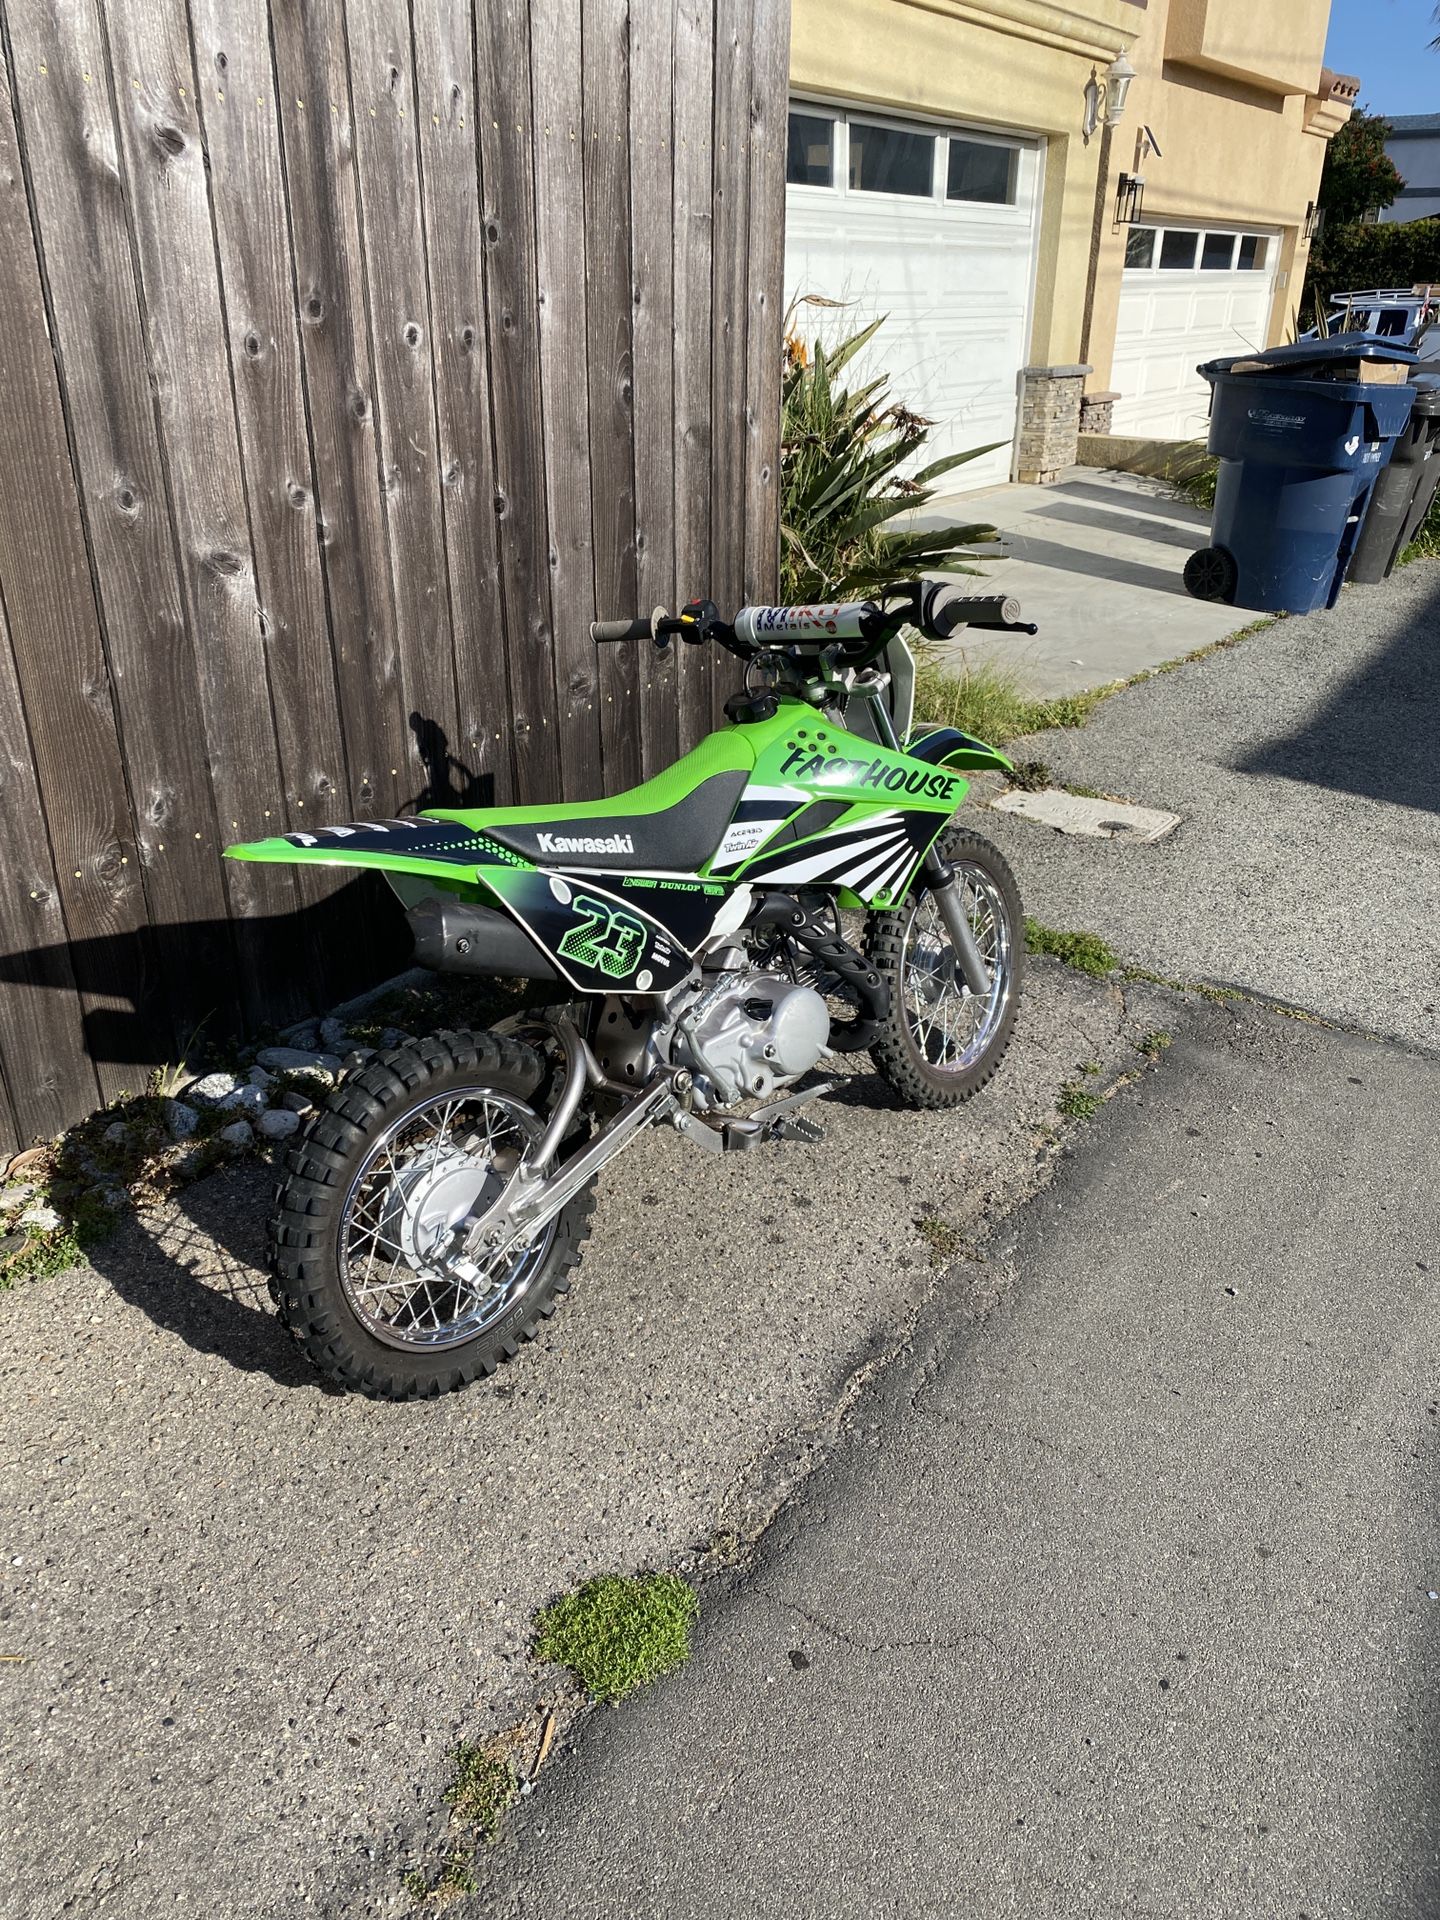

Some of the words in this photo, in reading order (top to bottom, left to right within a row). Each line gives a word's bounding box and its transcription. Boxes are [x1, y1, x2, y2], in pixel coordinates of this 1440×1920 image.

[763, 619, 811, 632] Metals
[779, 747, 960, 800] FASTHOUSE
[536, 833, 635, 853] Kawasaki
[660, 881, 701, 892] DUNLOP
[557, 895, 648, 979] 23
